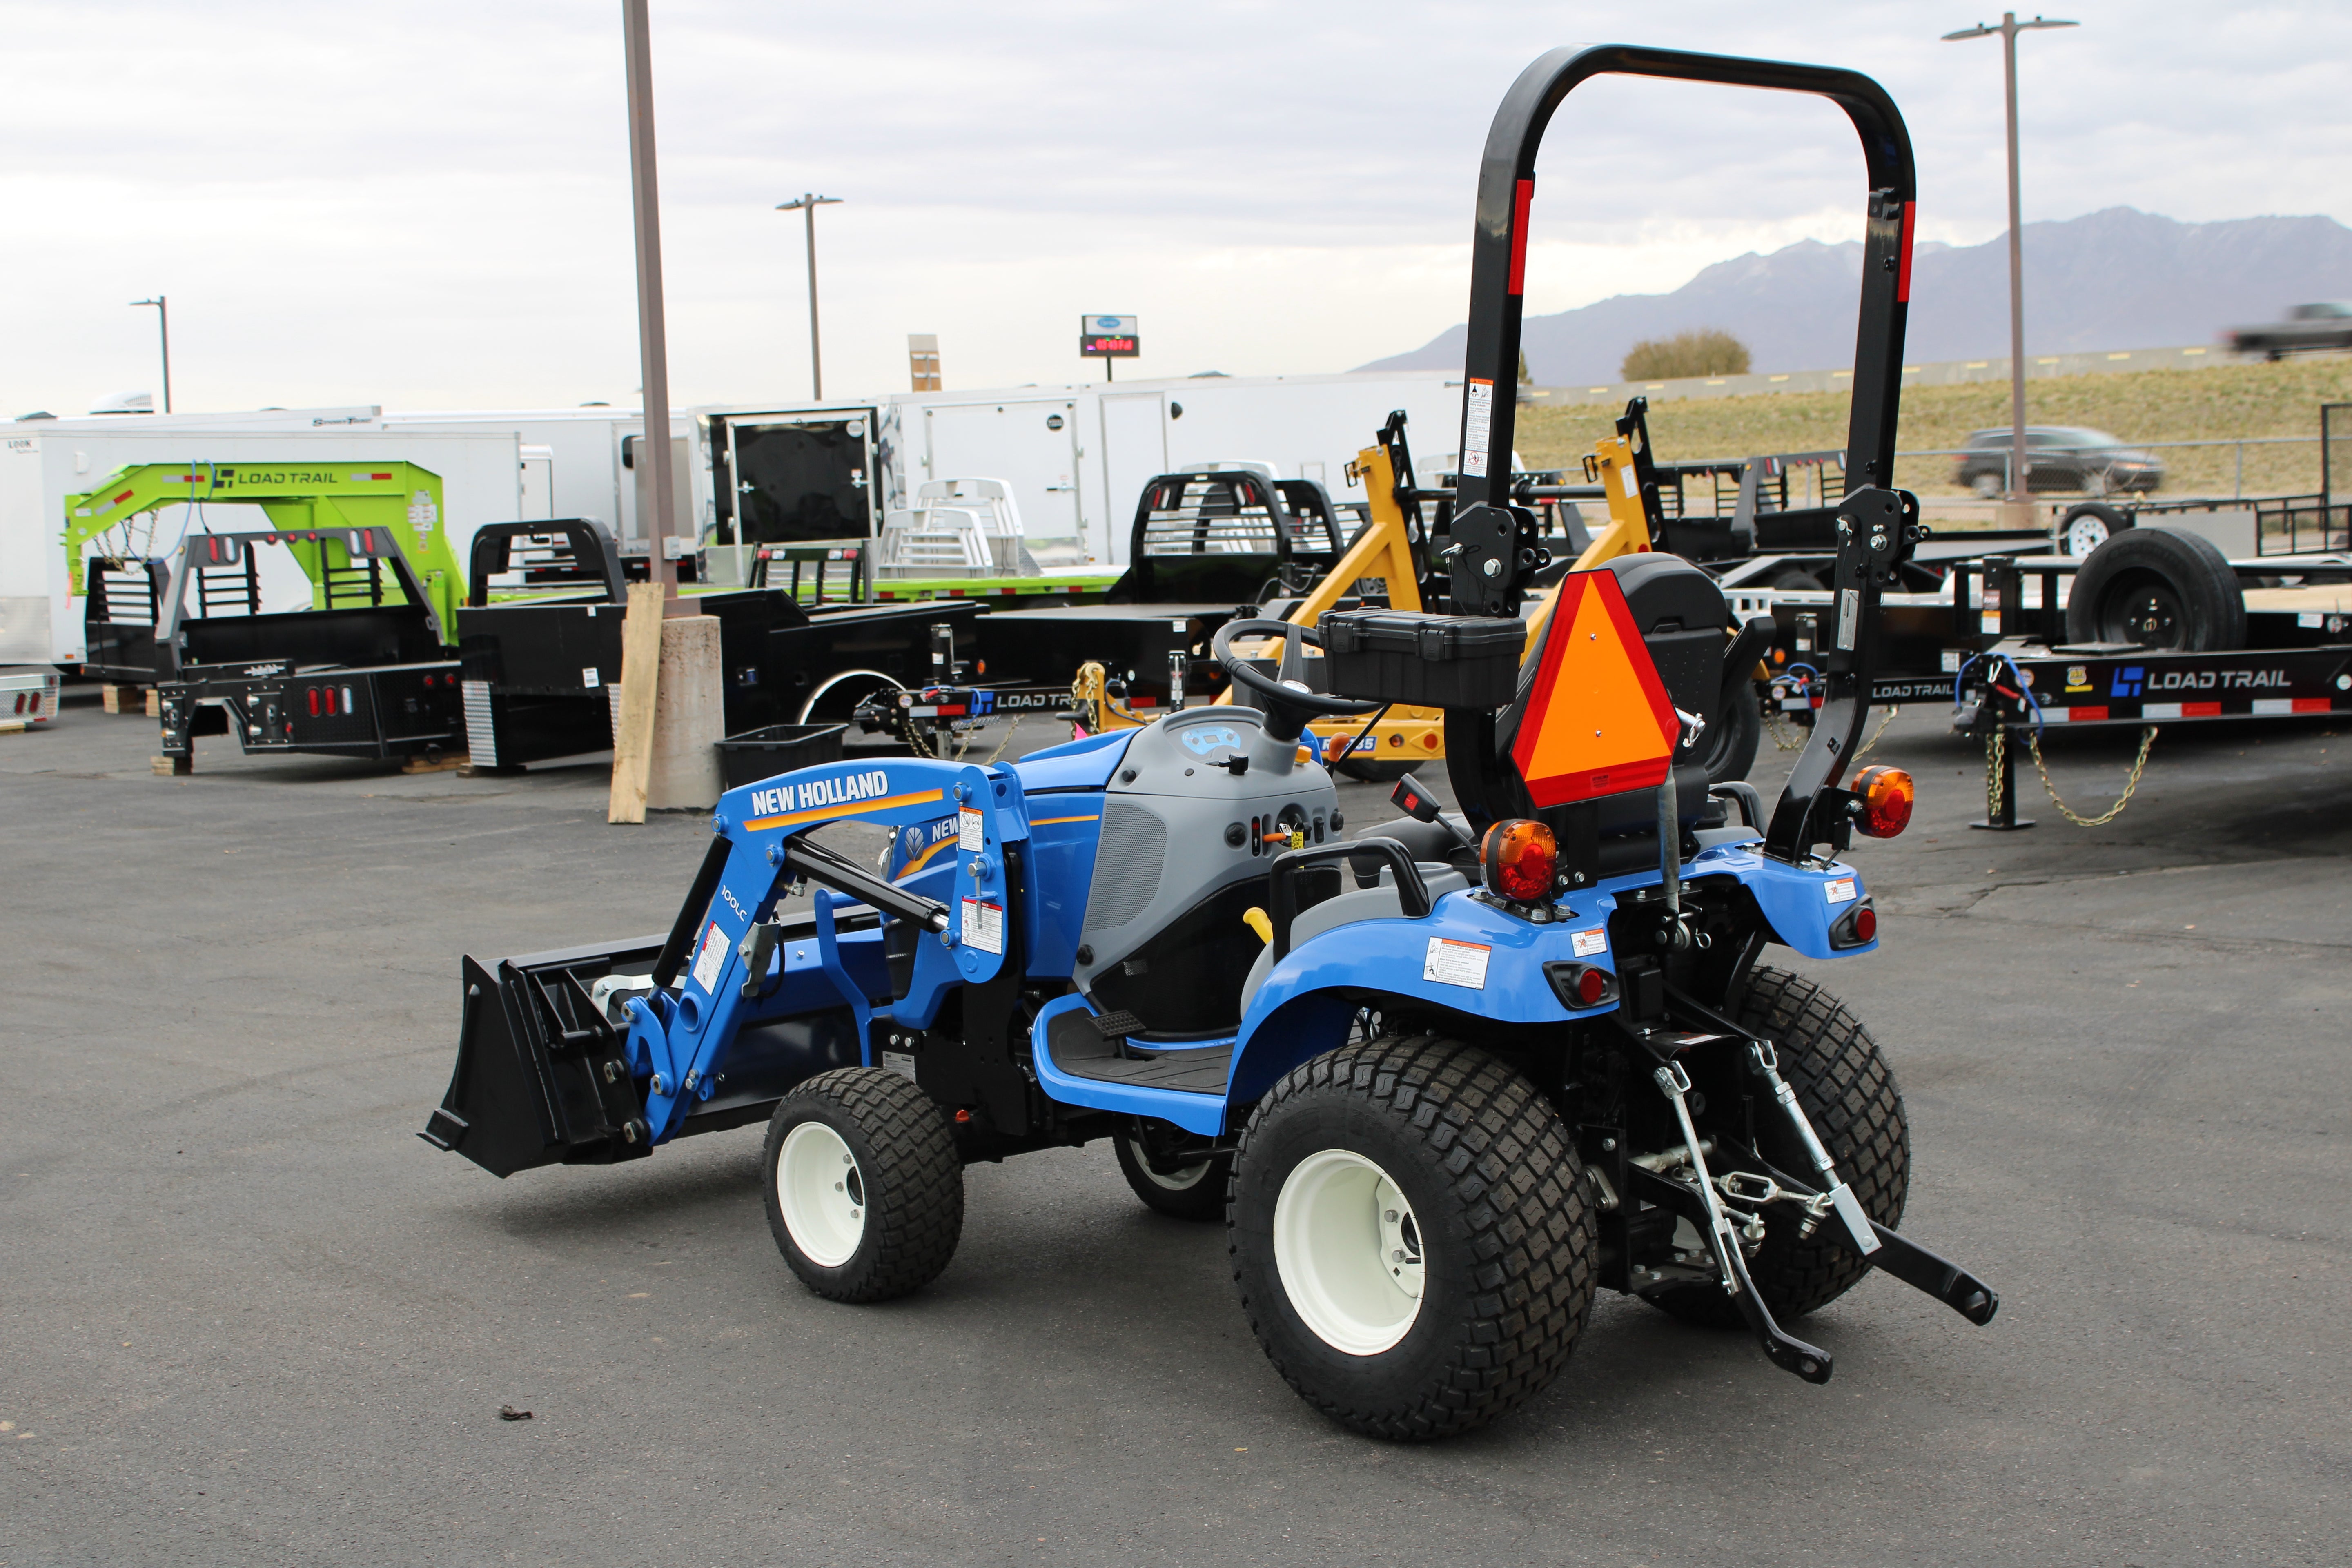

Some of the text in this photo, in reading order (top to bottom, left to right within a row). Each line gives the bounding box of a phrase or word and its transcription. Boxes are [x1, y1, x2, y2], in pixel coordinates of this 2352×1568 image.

[239, 473, 337, 484] LOAD TRAIL
[2147, 670, 2292, 689] LOAD TRAIL
[1873, 684, 1955, 698] LOAD TRAIL
[997, 695, 1046, 708] LOAD
[752, 770, 889, 816] NEW HOLLAND
[932, 817, 958, 842] NEW
[722, 884, 748, 922] 100LC
